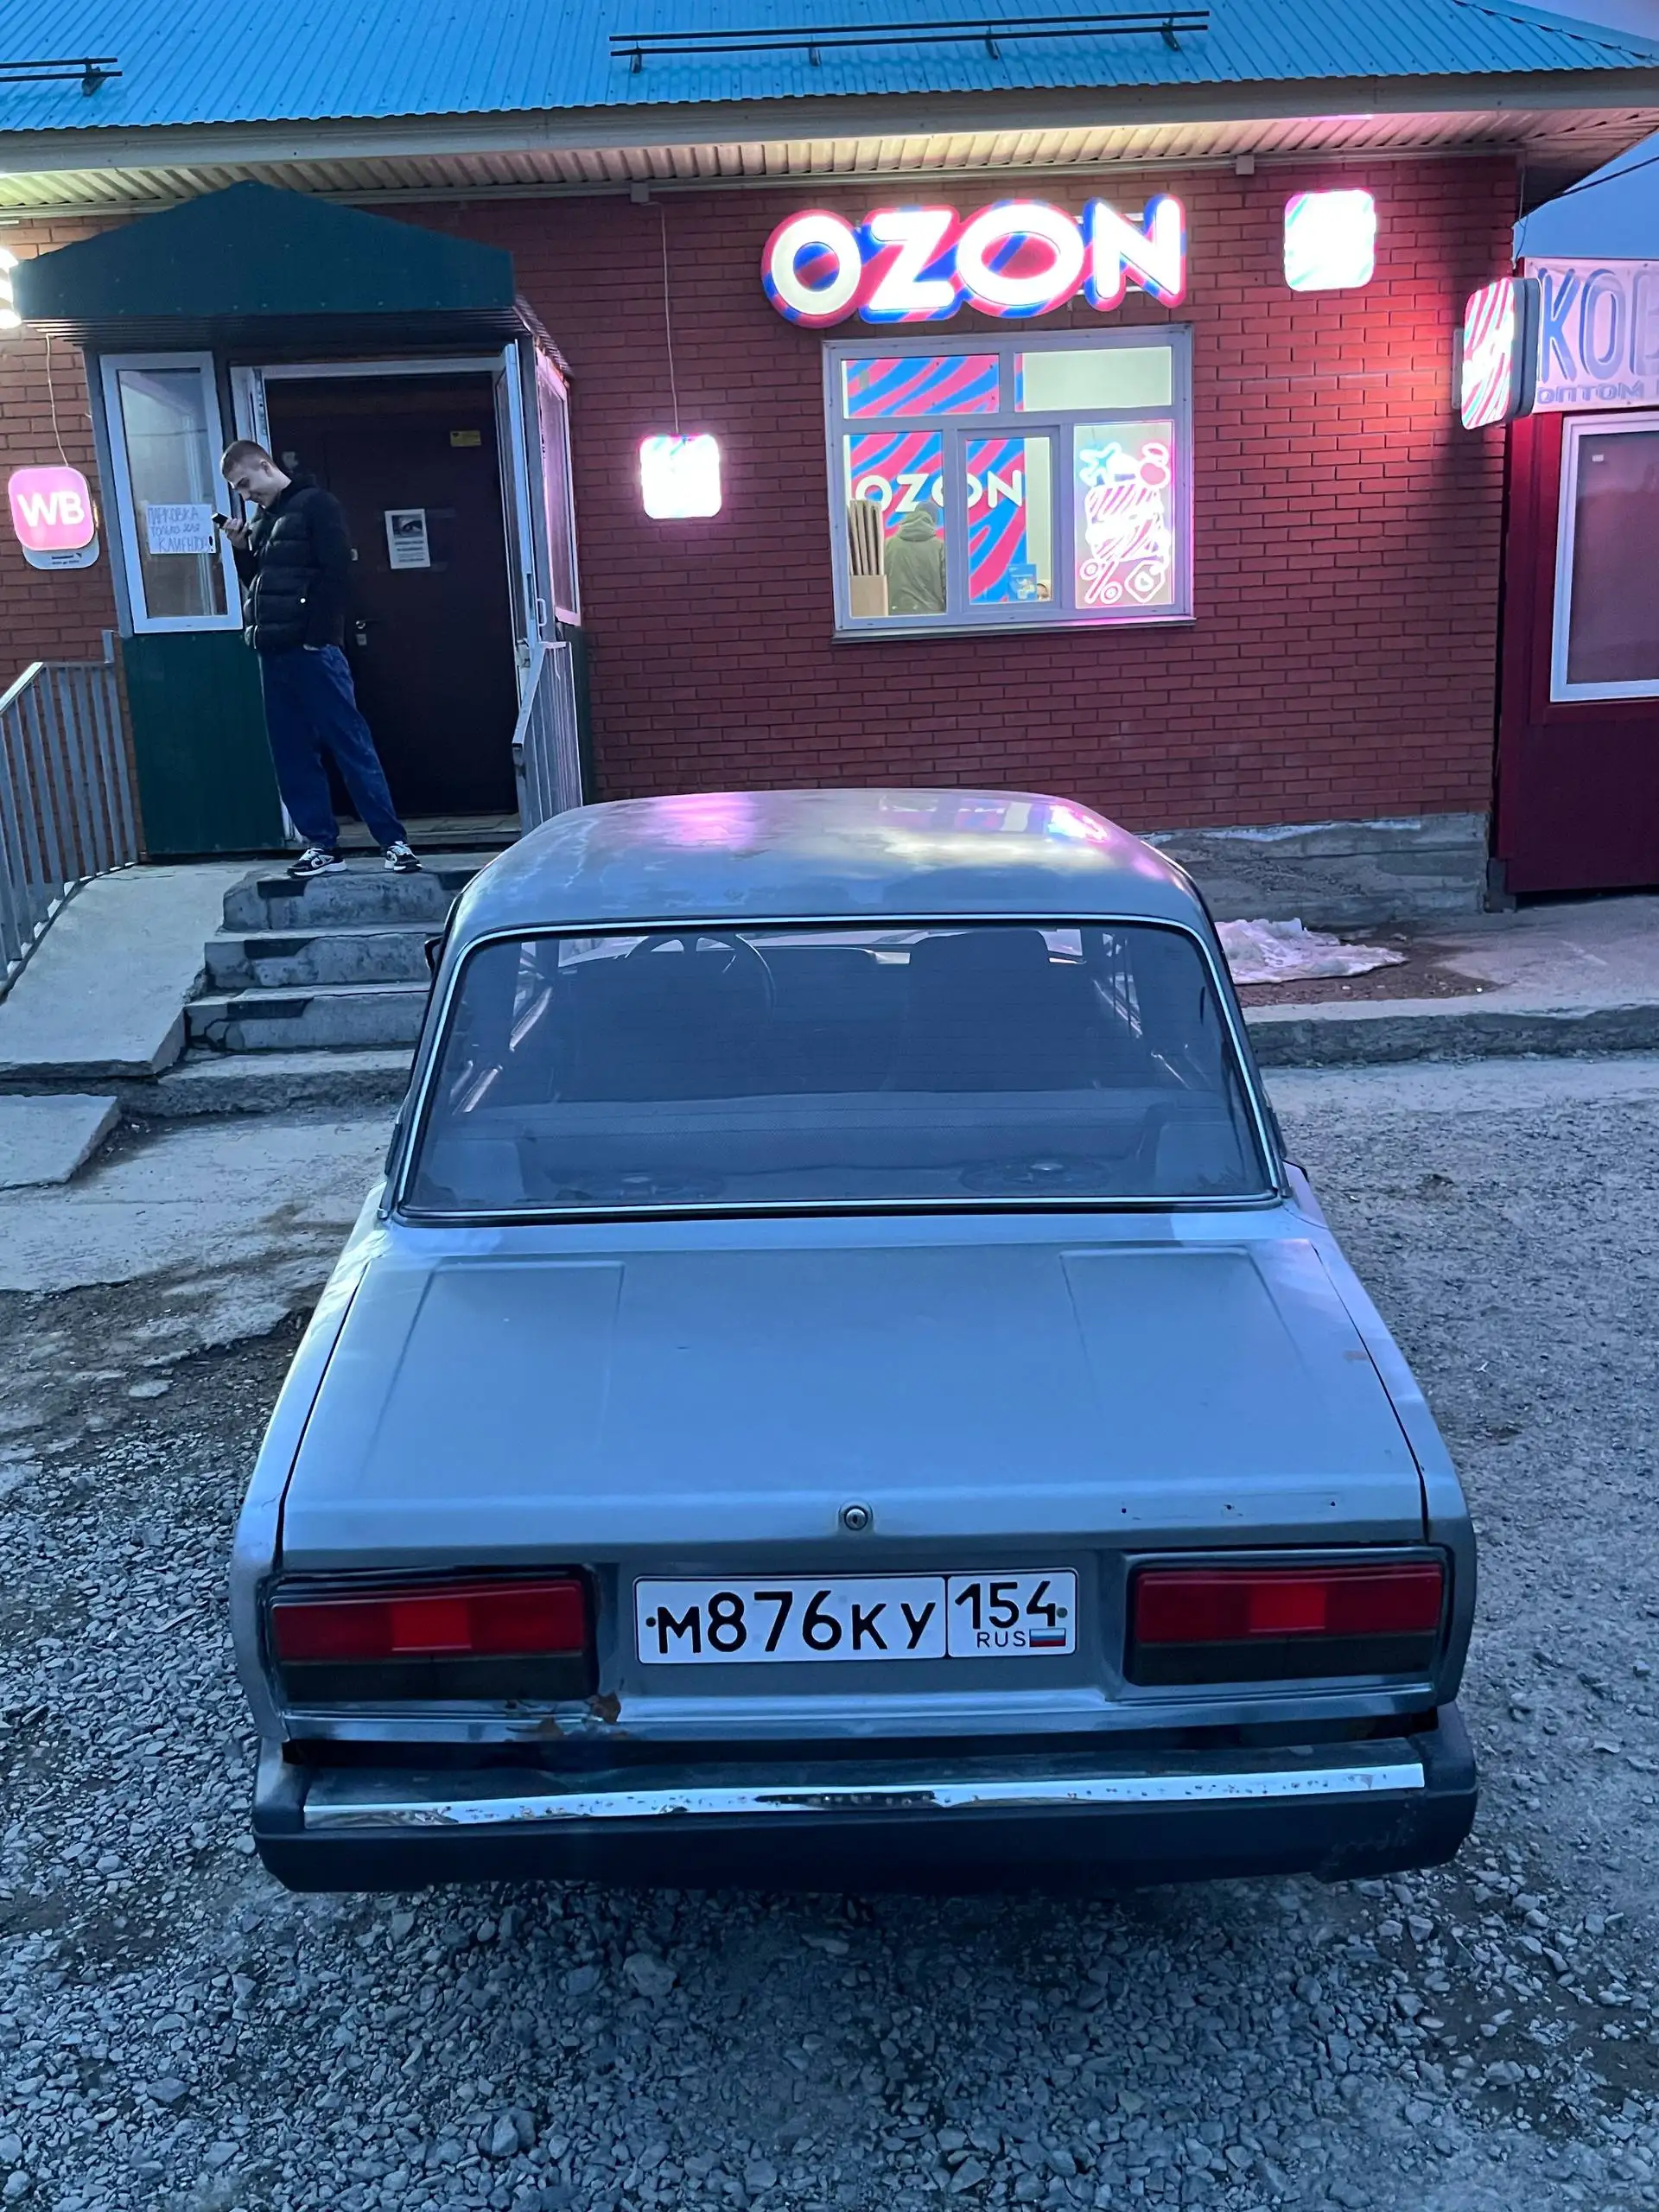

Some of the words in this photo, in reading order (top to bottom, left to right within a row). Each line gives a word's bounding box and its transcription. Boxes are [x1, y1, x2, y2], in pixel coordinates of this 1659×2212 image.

[760, 194, 1186, 328] OZON
[1536, 379, 1645, 404] ОПТОМ
[16, 491, 85, 527] WB
[955, 1580, 1057, 1630] 154
[976, 1630, 1027, 1649] RUS
